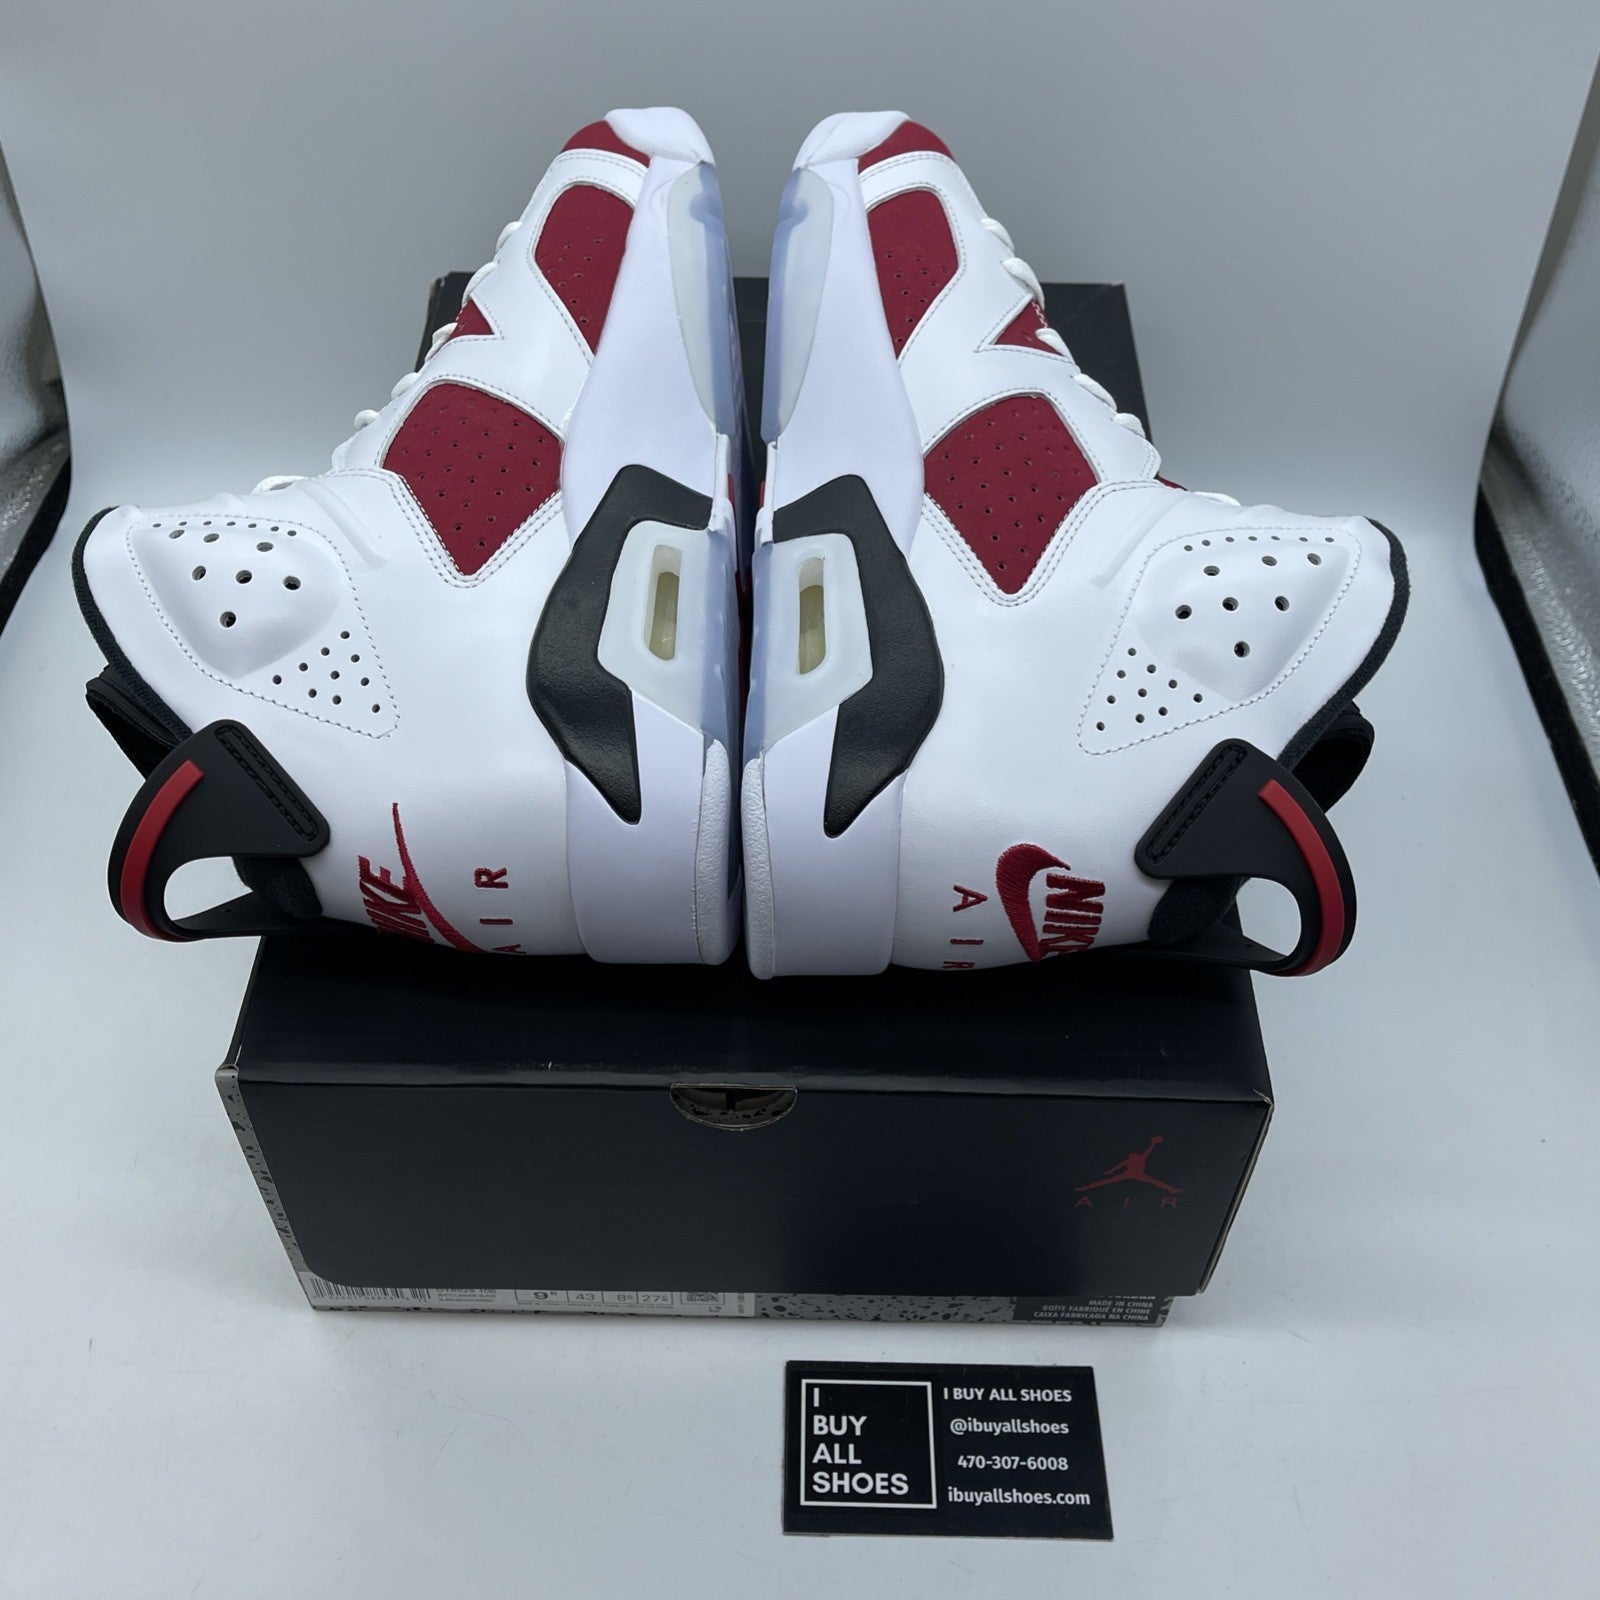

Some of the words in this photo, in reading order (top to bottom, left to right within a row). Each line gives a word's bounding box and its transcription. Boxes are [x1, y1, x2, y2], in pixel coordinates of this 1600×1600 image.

[1073, 1196, 1178, 1208] AIR
[575, 1293, 596, 1301] 43
[812, 1387, 820, 1407] I
[943, 1387, 949, 1400] I
[953, 1388, 985, 1401] BUY
[989, 1388, 1017, 1401] ALL
[1020, 1389, 1072, 1403] SHOES
[812, 1415, 867, 1436] BUY
[949, 1417, 1070, 1435] @ibuyallshoes
[811, 1443, 862, 1465] ALL
[957, 1455, 1069, 1471] 470-307-6008
[812, 1471, 909, 1495] SHOES
[947, 1486, 1091, 1506] ibuyallshoes.com
